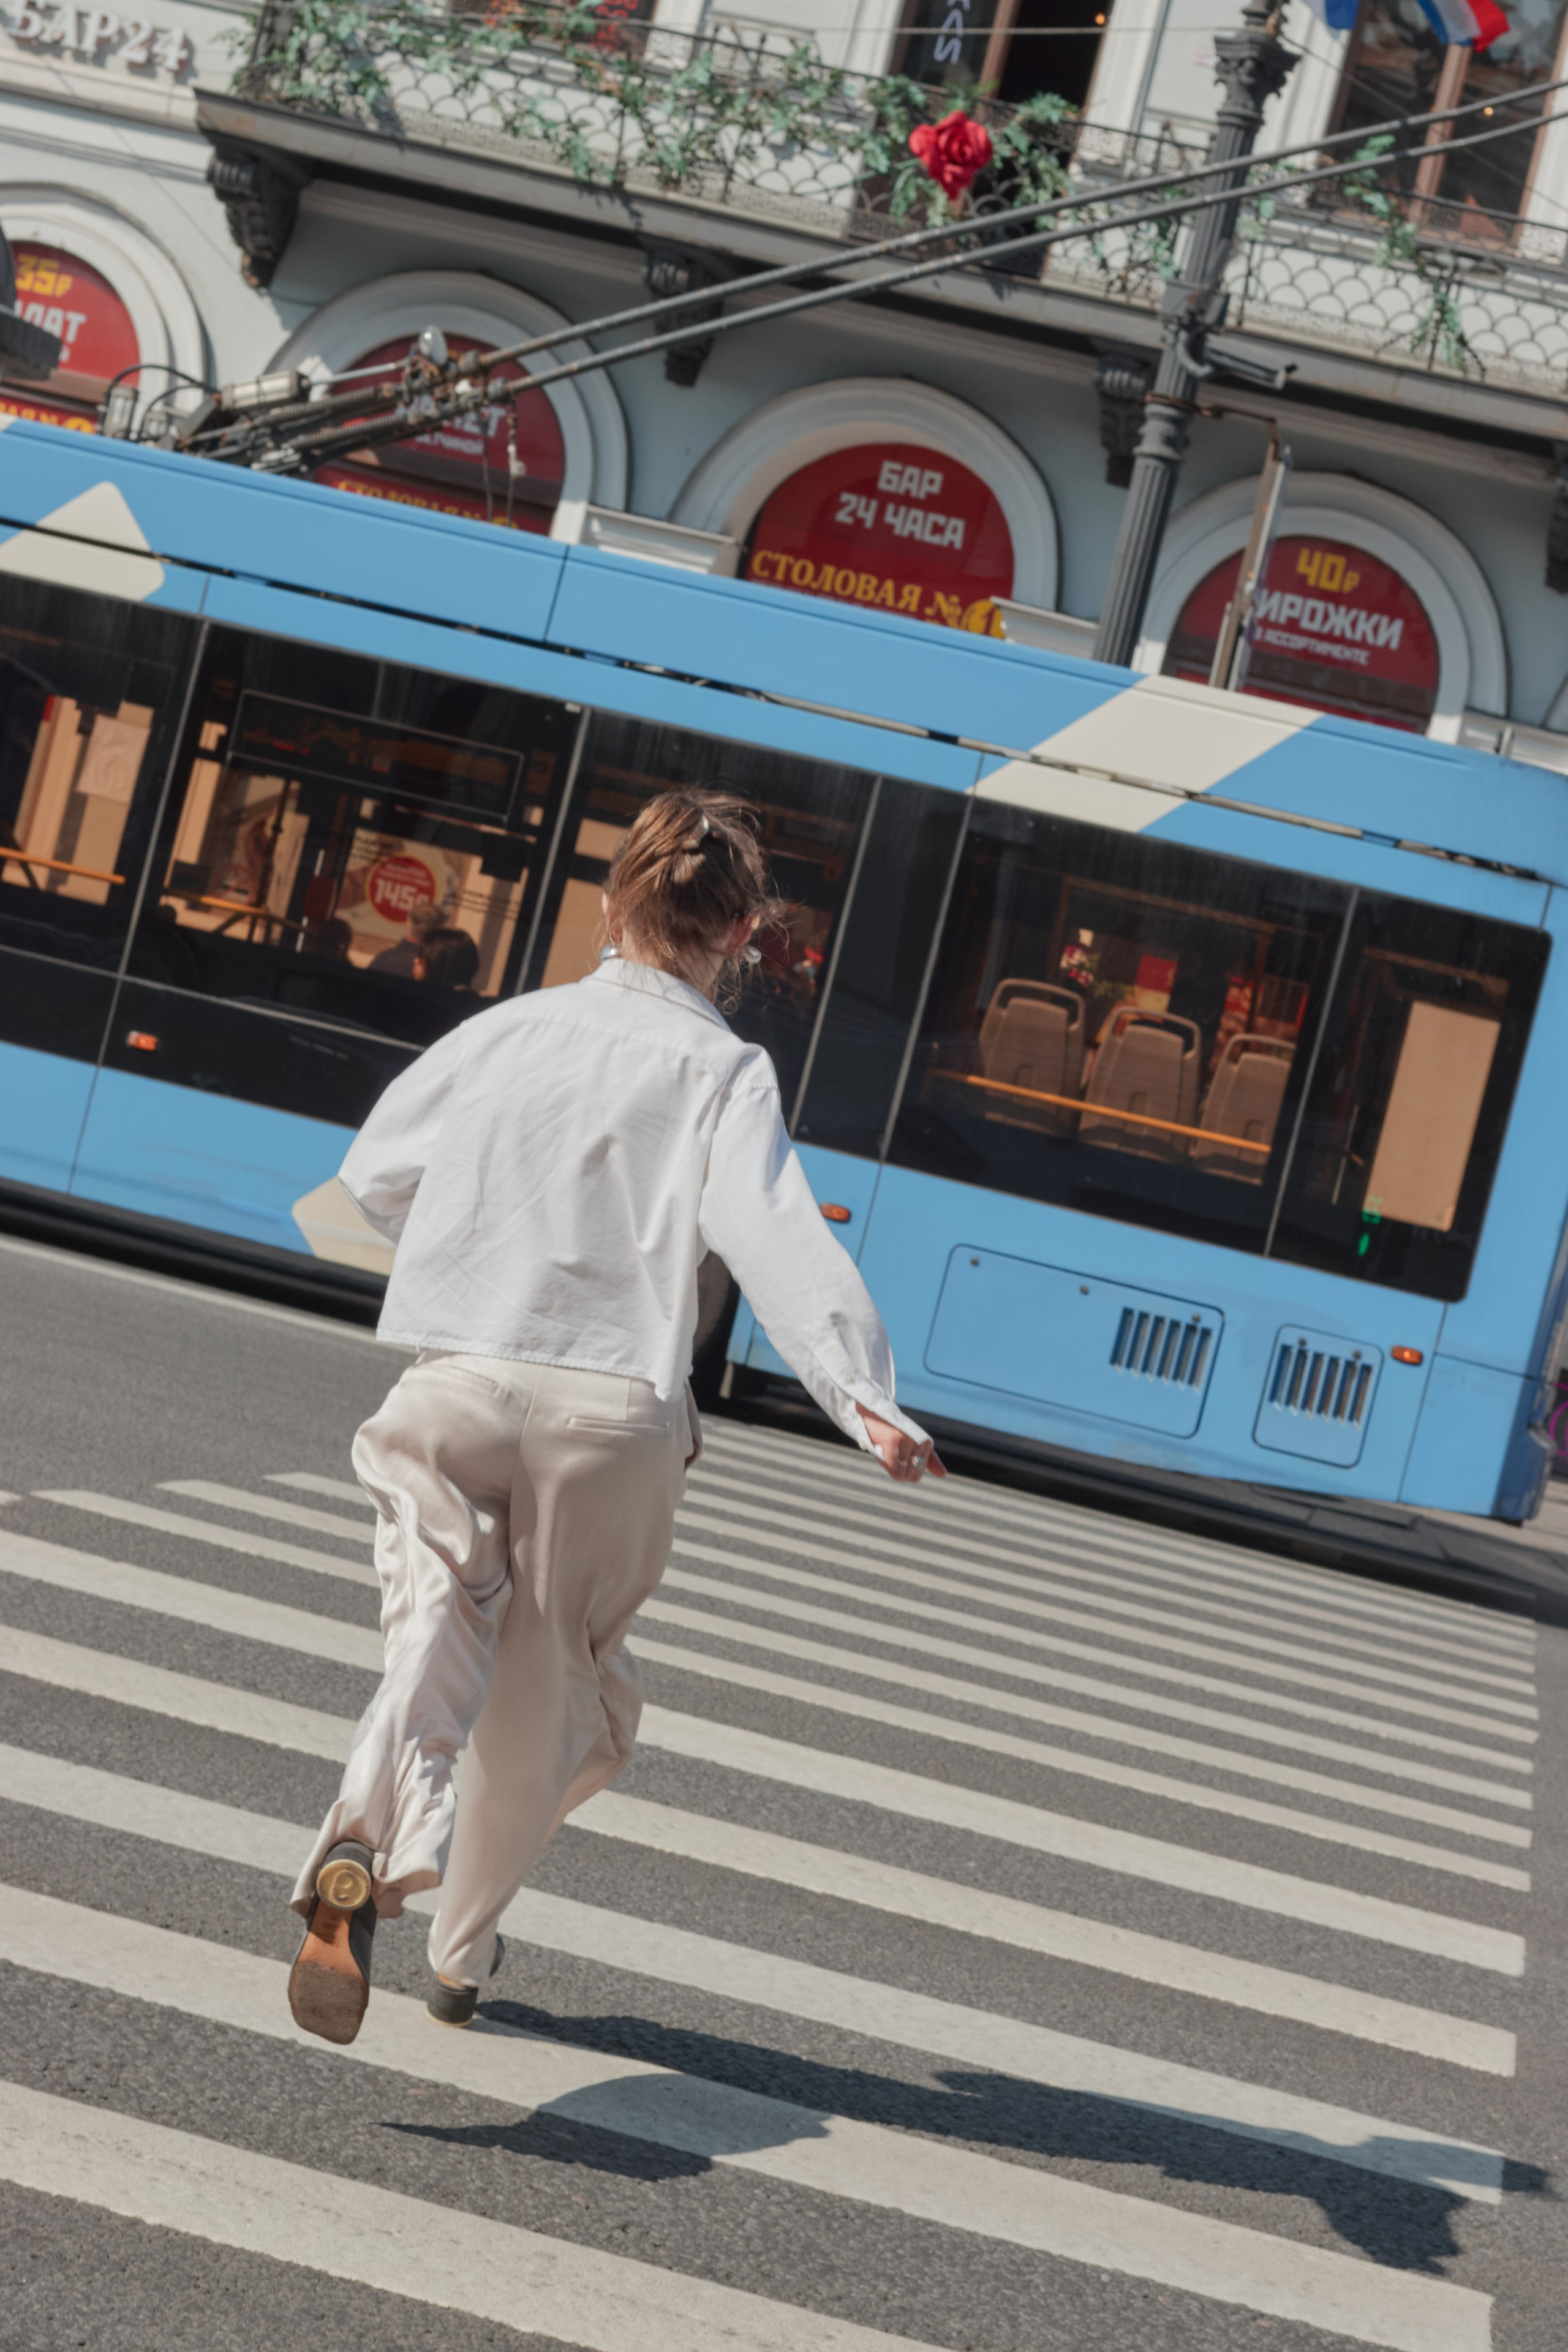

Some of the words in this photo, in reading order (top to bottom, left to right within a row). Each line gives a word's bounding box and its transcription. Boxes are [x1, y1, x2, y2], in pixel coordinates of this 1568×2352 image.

[877, 460, 943, 500] БАР
[835, 493, 878, 529] 24
[884, 502, 966, 549] ЧАСА
[750, 550, 923, 612] СТОЛОВАЯ
[1254, 588, 1404, 650] ИРОЖКИ
